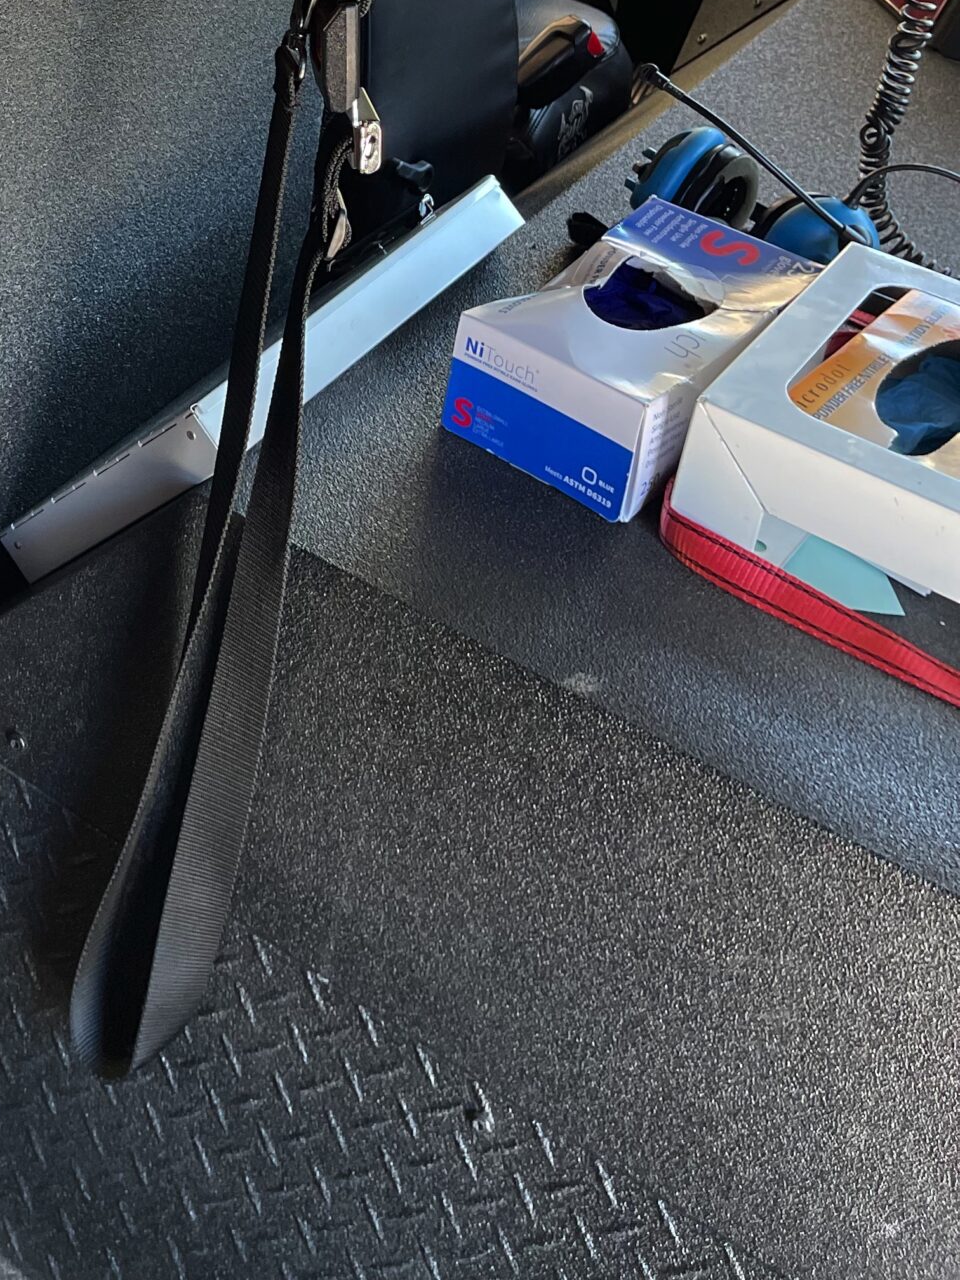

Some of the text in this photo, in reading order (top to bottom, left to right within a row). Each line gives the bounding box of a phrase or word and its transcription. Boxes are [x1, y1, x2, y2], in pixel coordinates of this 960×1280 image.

[699, 229, 761, 266] S
[451, 396, 474, 428] S
[563, 475, 586, 496] ASTM
[586, 488, 612, 508] D6319
[598, 480, 615, 494] BLUE
